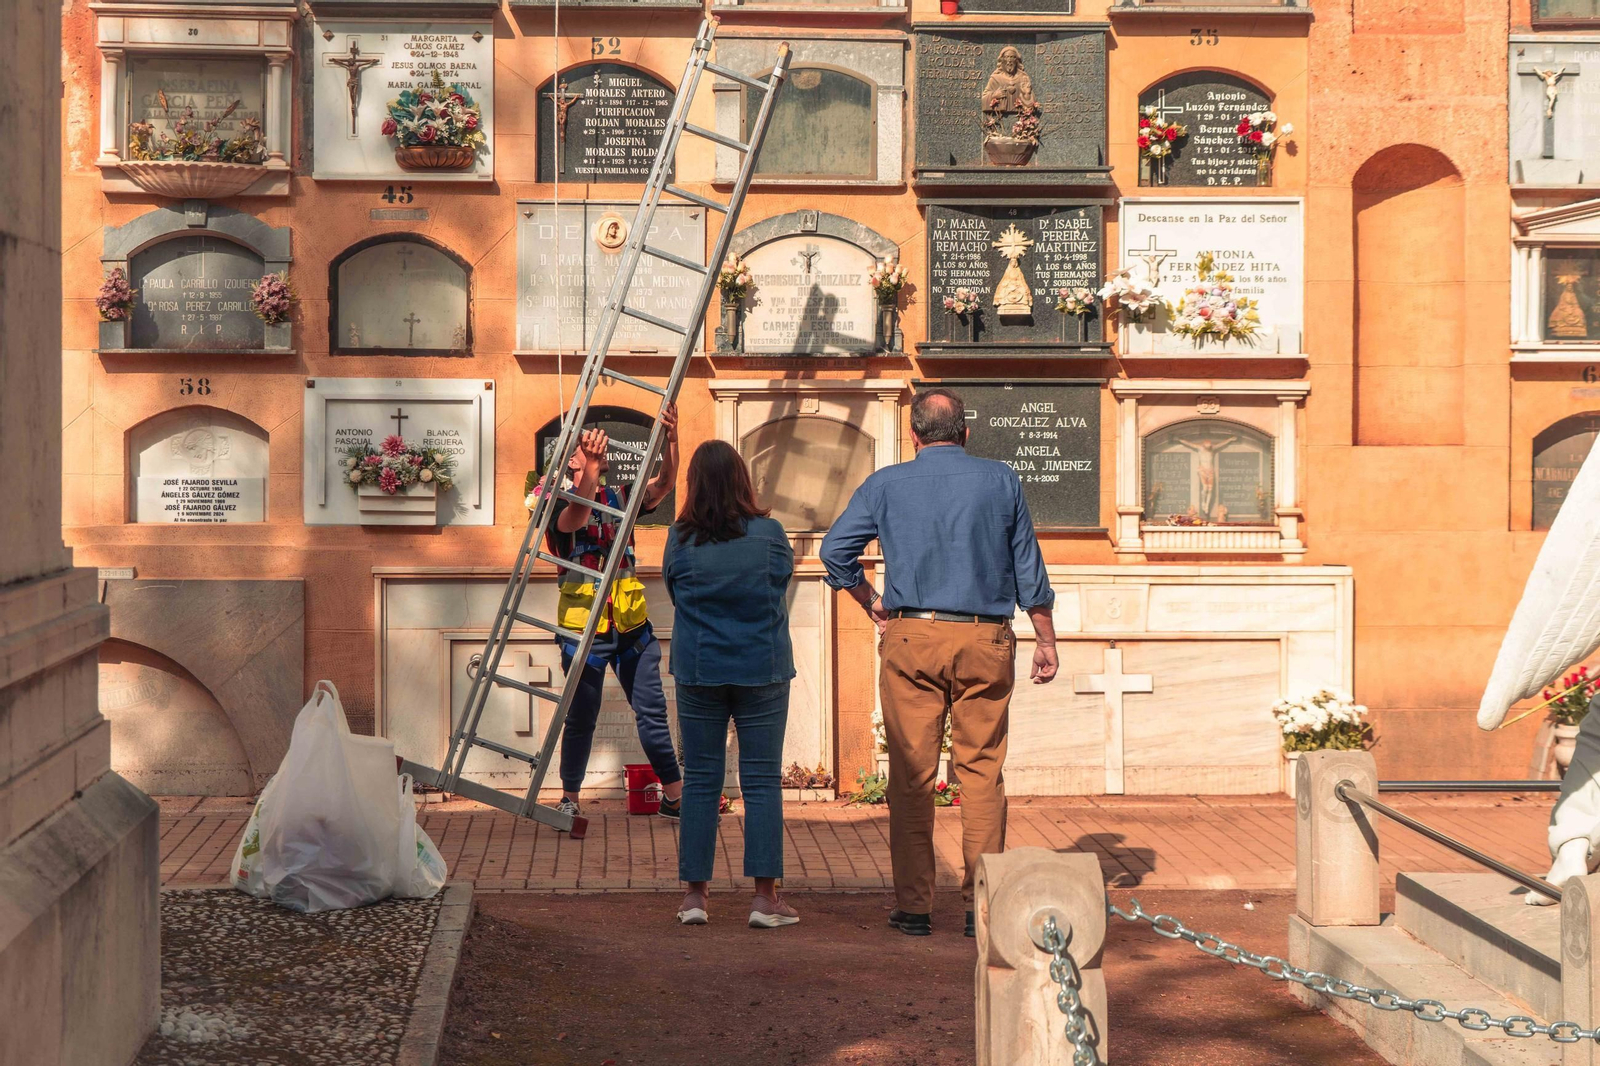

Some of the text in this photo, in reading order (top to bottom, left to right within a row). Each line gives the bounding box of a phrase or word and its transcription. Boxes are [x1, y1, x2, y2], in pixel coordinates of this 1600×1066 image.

[391, 62, 477, 70] JESUS OLMOS BAENA
[609, 78, 642, 87] MIGUEL
[585, 89, 666, 98] MORALES ARTERO
[1206, 91, 1247, 101] Antonio
[1185, 101, 1268, 111] Luzón Fernández
[595, 107, 656, 117] PURIFICACION
[585, 118, 666, 127] ROLDAN MORALES
[604, 137, 646, 146] JOSEFINA
[1193, 134, 1234, 145] Sánchez
[585, 148, 626, 156] MORALES
[381, 185, 414, 204] 45
[1138, 213, 1184, 223] Descanse
[1205, 213, 1214, 223] la
[1219, 214, 1237, 223] Paz
[1241, 213, 1255, 223] del
[1260, 213, 1288, 223] Señor
[950, 219, 987, 230] MARIA
[1055, 219, 1093, 230] ISABEL
[933, 230, 990, 241] MARTINEZ
[1042, 230, 1090, 241] PEREIRA
[936, 242, 988, 252] REMACHO
[1035, 241, 1097, 252] MARTINEZ
[943, 261, 956, 269] LOS
[970, 261, 988, 269] AÑOS
[1076, 261, 1097, 270] AÑOS
[1251, 263, 1281, 271] HITA
[653, 275, 691, 287] MEDINA
[1055, 272, 1097, 280] HERMANOS
[1239, 273, 1287, 282] los 86 años
[149, 279, 218, 289] PAULA CARRILLO
[950, 278, 983, 286] SOBRINOS
[1053, 280, 1088, 288] SOBRINOS
[946, 286, 955, 294] TE
[1235, 286, 1265, 294] familia
[185, 301, 211, 311] PEREZ
[763, 321, 854, 331] CARMEN ESCOBAR
[180, 378, 211, 396] 58
[1020, 402, 1057, 412] ANGEL
[990, 417, 1088, 427] GONZALEZ ALVA
[1015, 446, 1060, 456] ANGELA
[1042, 461, 1092, 471] JIMENEZ
